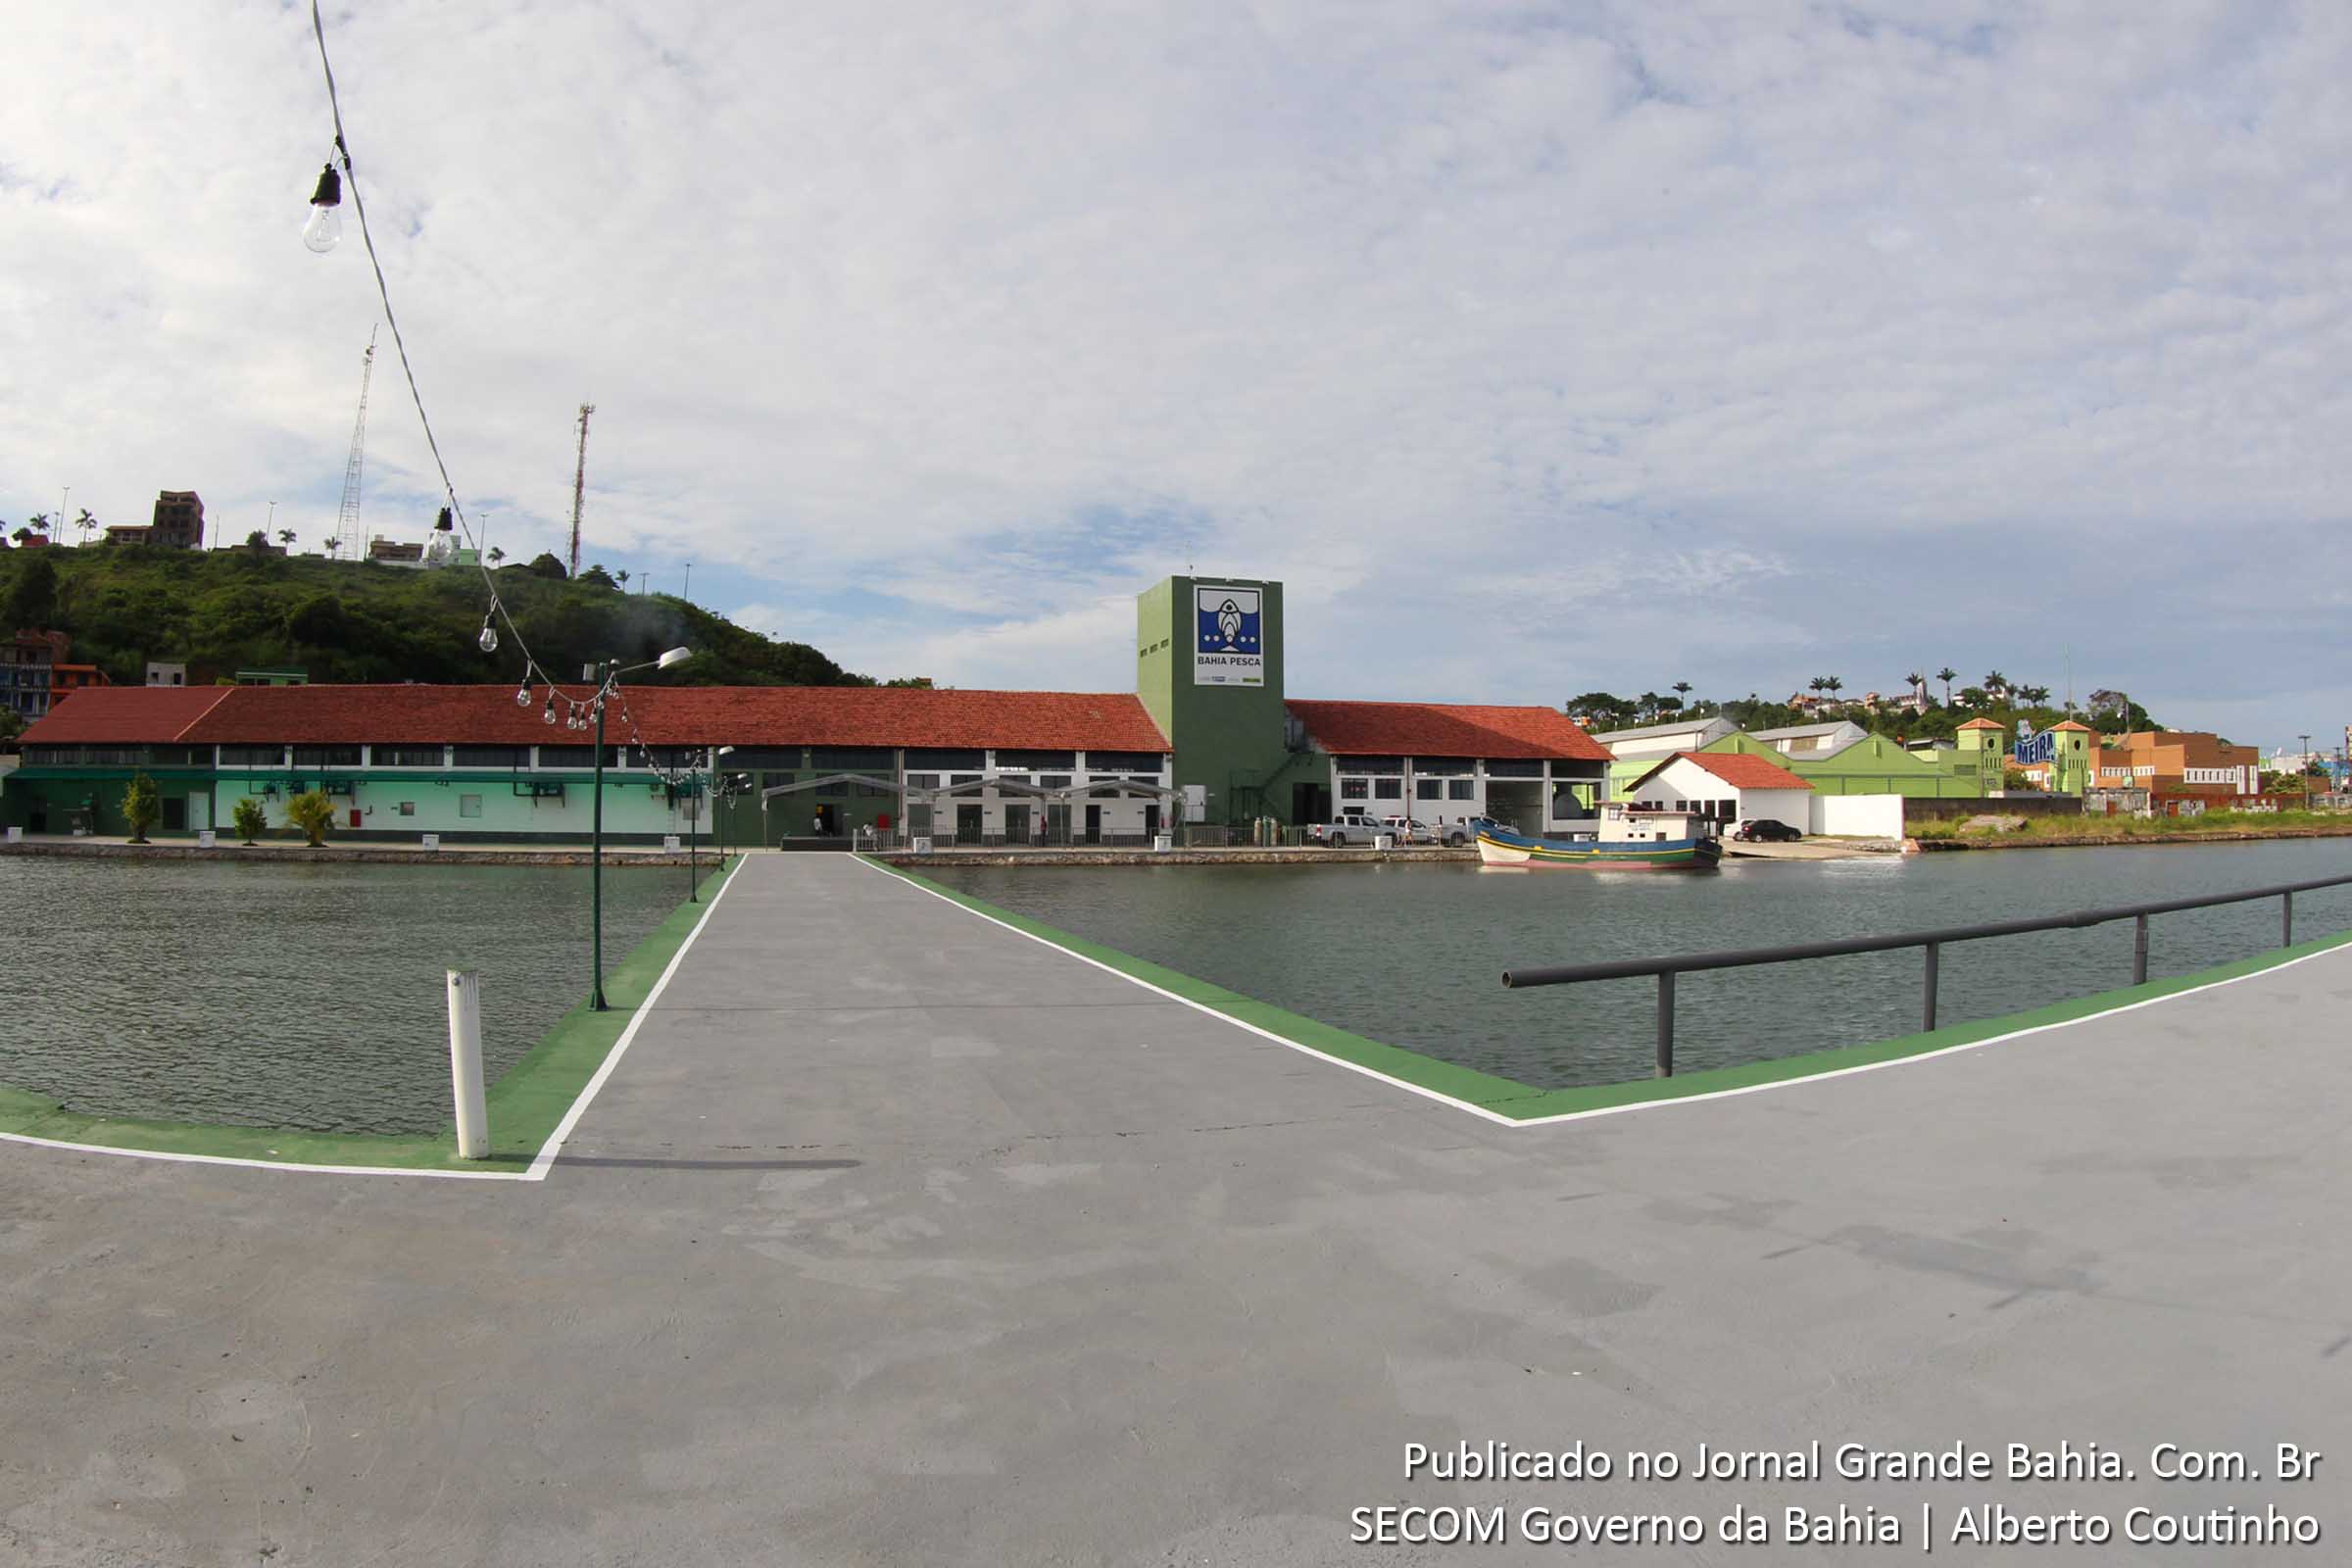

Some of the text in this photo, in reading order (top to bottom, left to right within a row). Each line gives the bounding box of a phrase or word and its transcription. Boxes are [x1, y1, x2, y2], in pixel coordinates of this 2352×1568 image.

[1198, 657, 1261, 666] BAHIA PESCA
[2017, 733, 2055, 763] MEIRA
